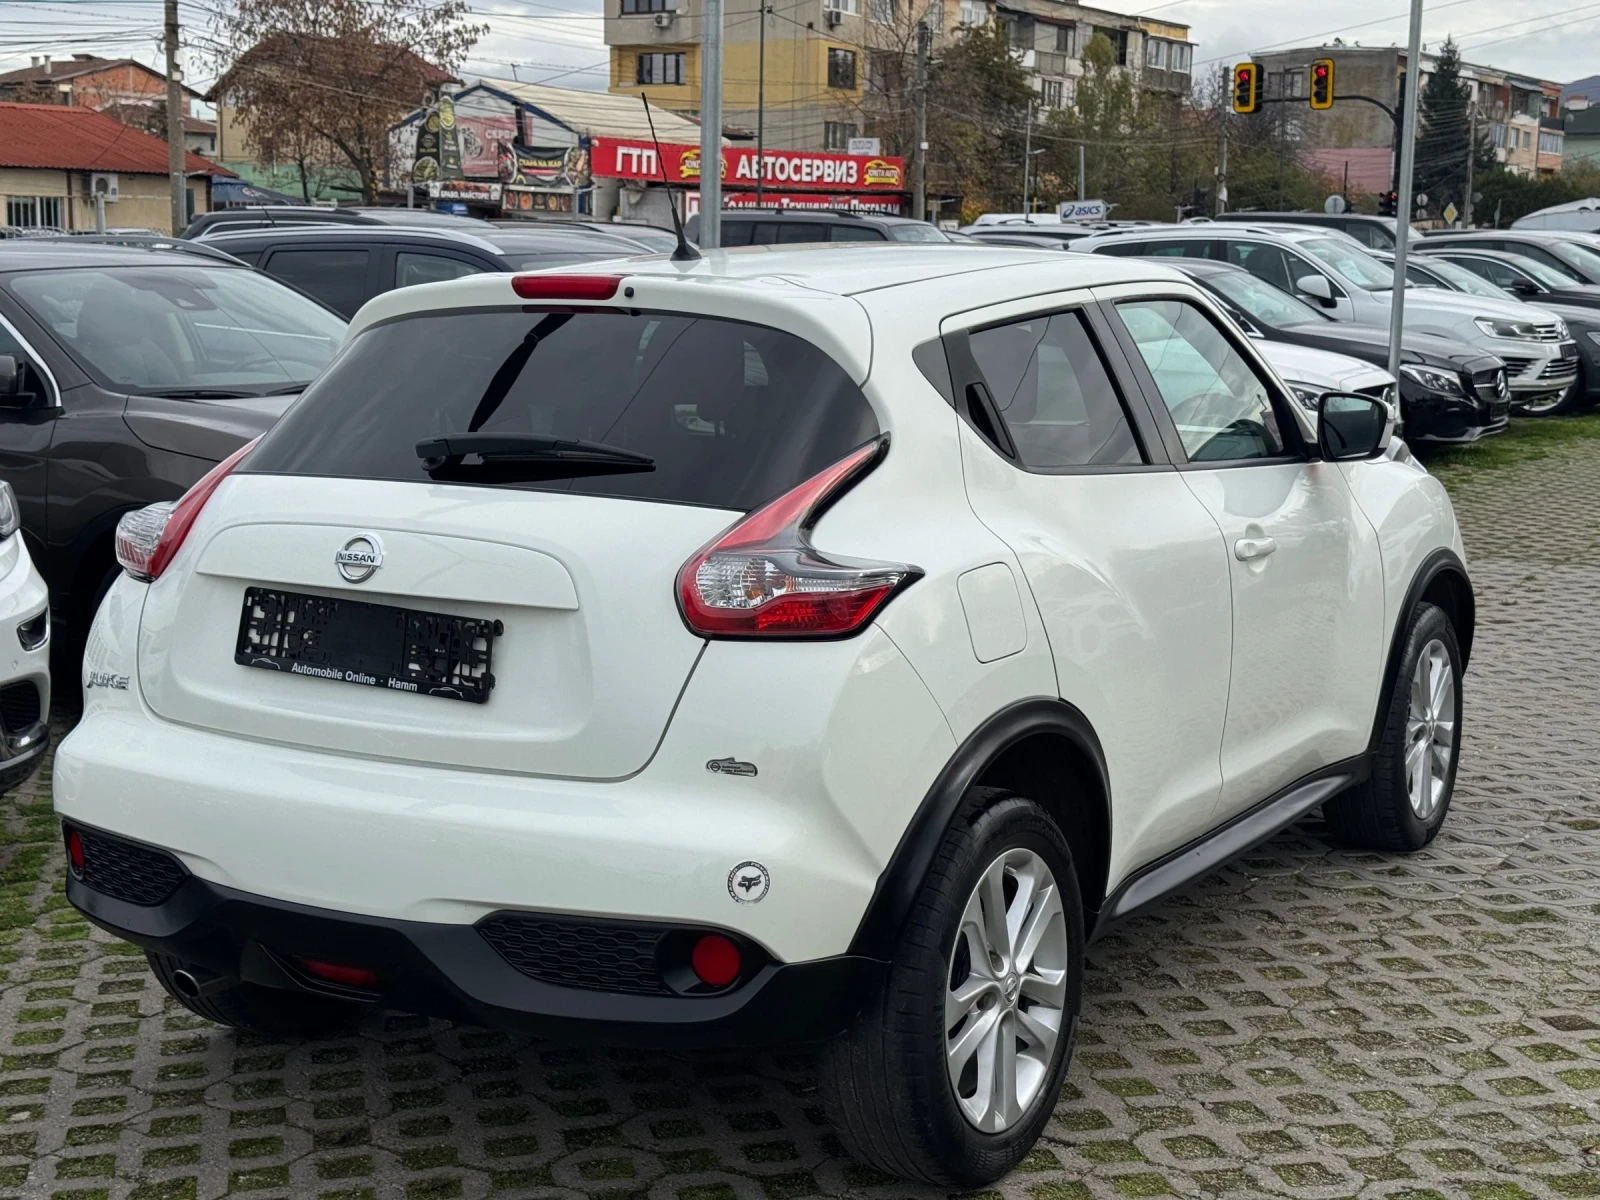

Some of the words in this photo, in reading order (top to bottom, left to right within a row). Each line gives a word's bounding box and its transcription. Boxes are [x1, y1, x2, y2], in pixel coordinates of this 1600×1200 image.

[615, 146, 657, 176] ГТП
[735, 153, 858, 185] АВТОСЕРВИЗ
[338, 552, 376, 564] NISSAN
[86, 671, 131, 690] JUKE
[291, 662, 344, 680] Automobile
[345, 671, 377, 685] Online
[387, 677, 418, 692] Hamm
